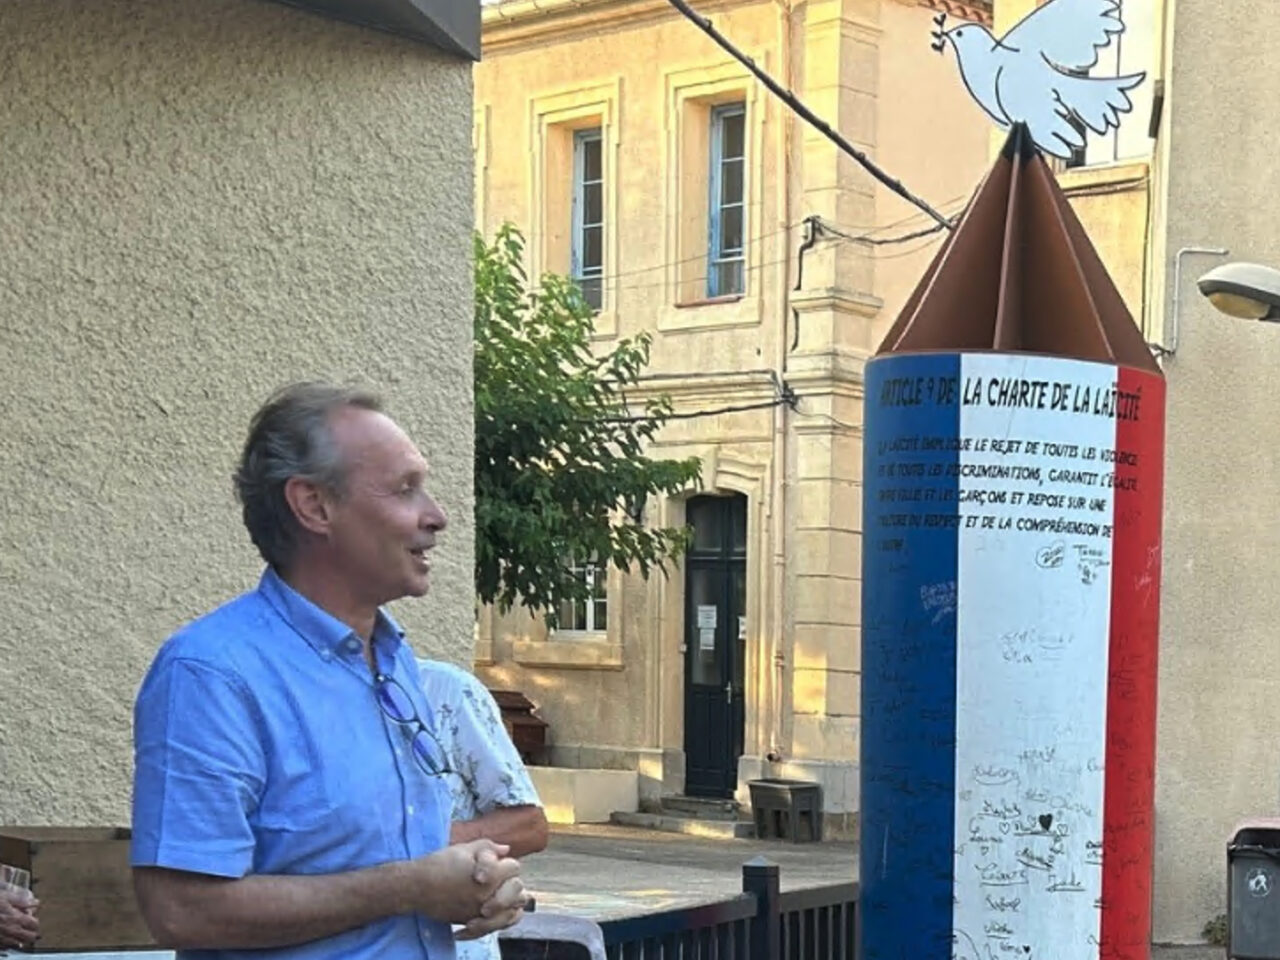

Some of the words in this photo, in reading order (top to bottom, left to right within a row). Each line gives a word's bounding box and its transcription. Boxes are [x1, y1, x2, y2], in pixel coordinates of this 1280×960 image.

[936, 376, 956, 406] DE
[962, 376, 983, 406] LA
[987, 377, 1049, 410] CHARTE
[1050, 381, 1072, 411] DE
[1073, 384, 1091, 414] LA
[1093, 381, 1142, 421] LAÏCITÉ
[974, 438, 989, 452] LE
[990, 438, 1023, 456] REJET
[1024, 441, 1042, 456] DE
[1042, 442, 1079, 459] TOUTES
[1081, 446, 1097, 461] LES
[1047, 467, 1099, 486] GARANTIT
[957, 489, 1007, 508] GARÇONS
[1010, 491, 1025, 506] ET
[1027, 492, 1066, 509] REPOSE
[1067, 496, 1087, 511] SUR
[1088, 498, 1107, 513] UNE
[965, 515, 980, 529] ET
[981, 516, 996, 530] DE
[998, 516, 1013, 530] LA
[1016, 516, 1099, 538] COMPRÉHENSION
[1101, 524, 1113, 538] DE
